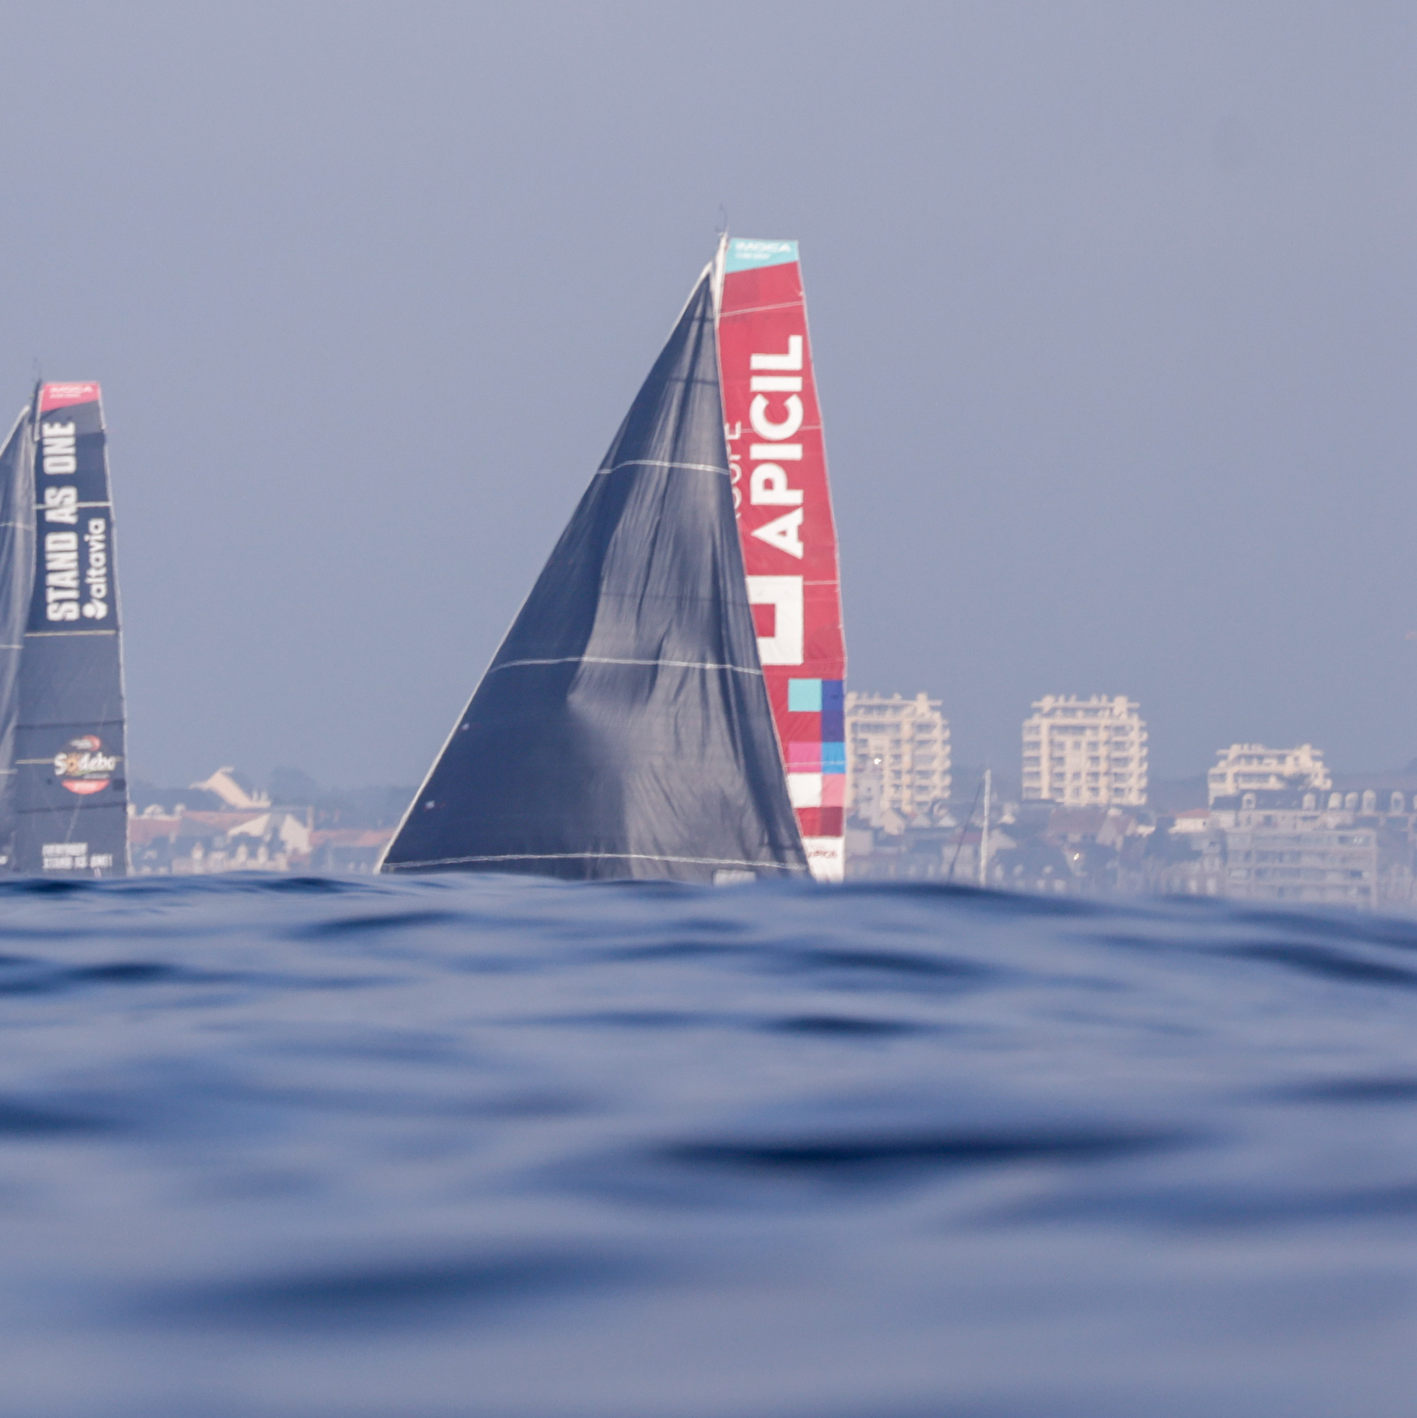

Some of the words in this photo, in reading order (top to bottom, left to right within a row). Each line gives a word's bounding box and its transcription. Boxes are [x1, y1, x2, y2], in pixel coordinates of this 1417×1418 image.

[42, 421, 77, 475] ONE
[749, 334, 804, 560] APICIL
[44, 486, 78, 524] AS
[45, 531, 80, 621] STAND
[84, 517, 108, 599] altavia
[54, 751, 116, 776] Sodebo
